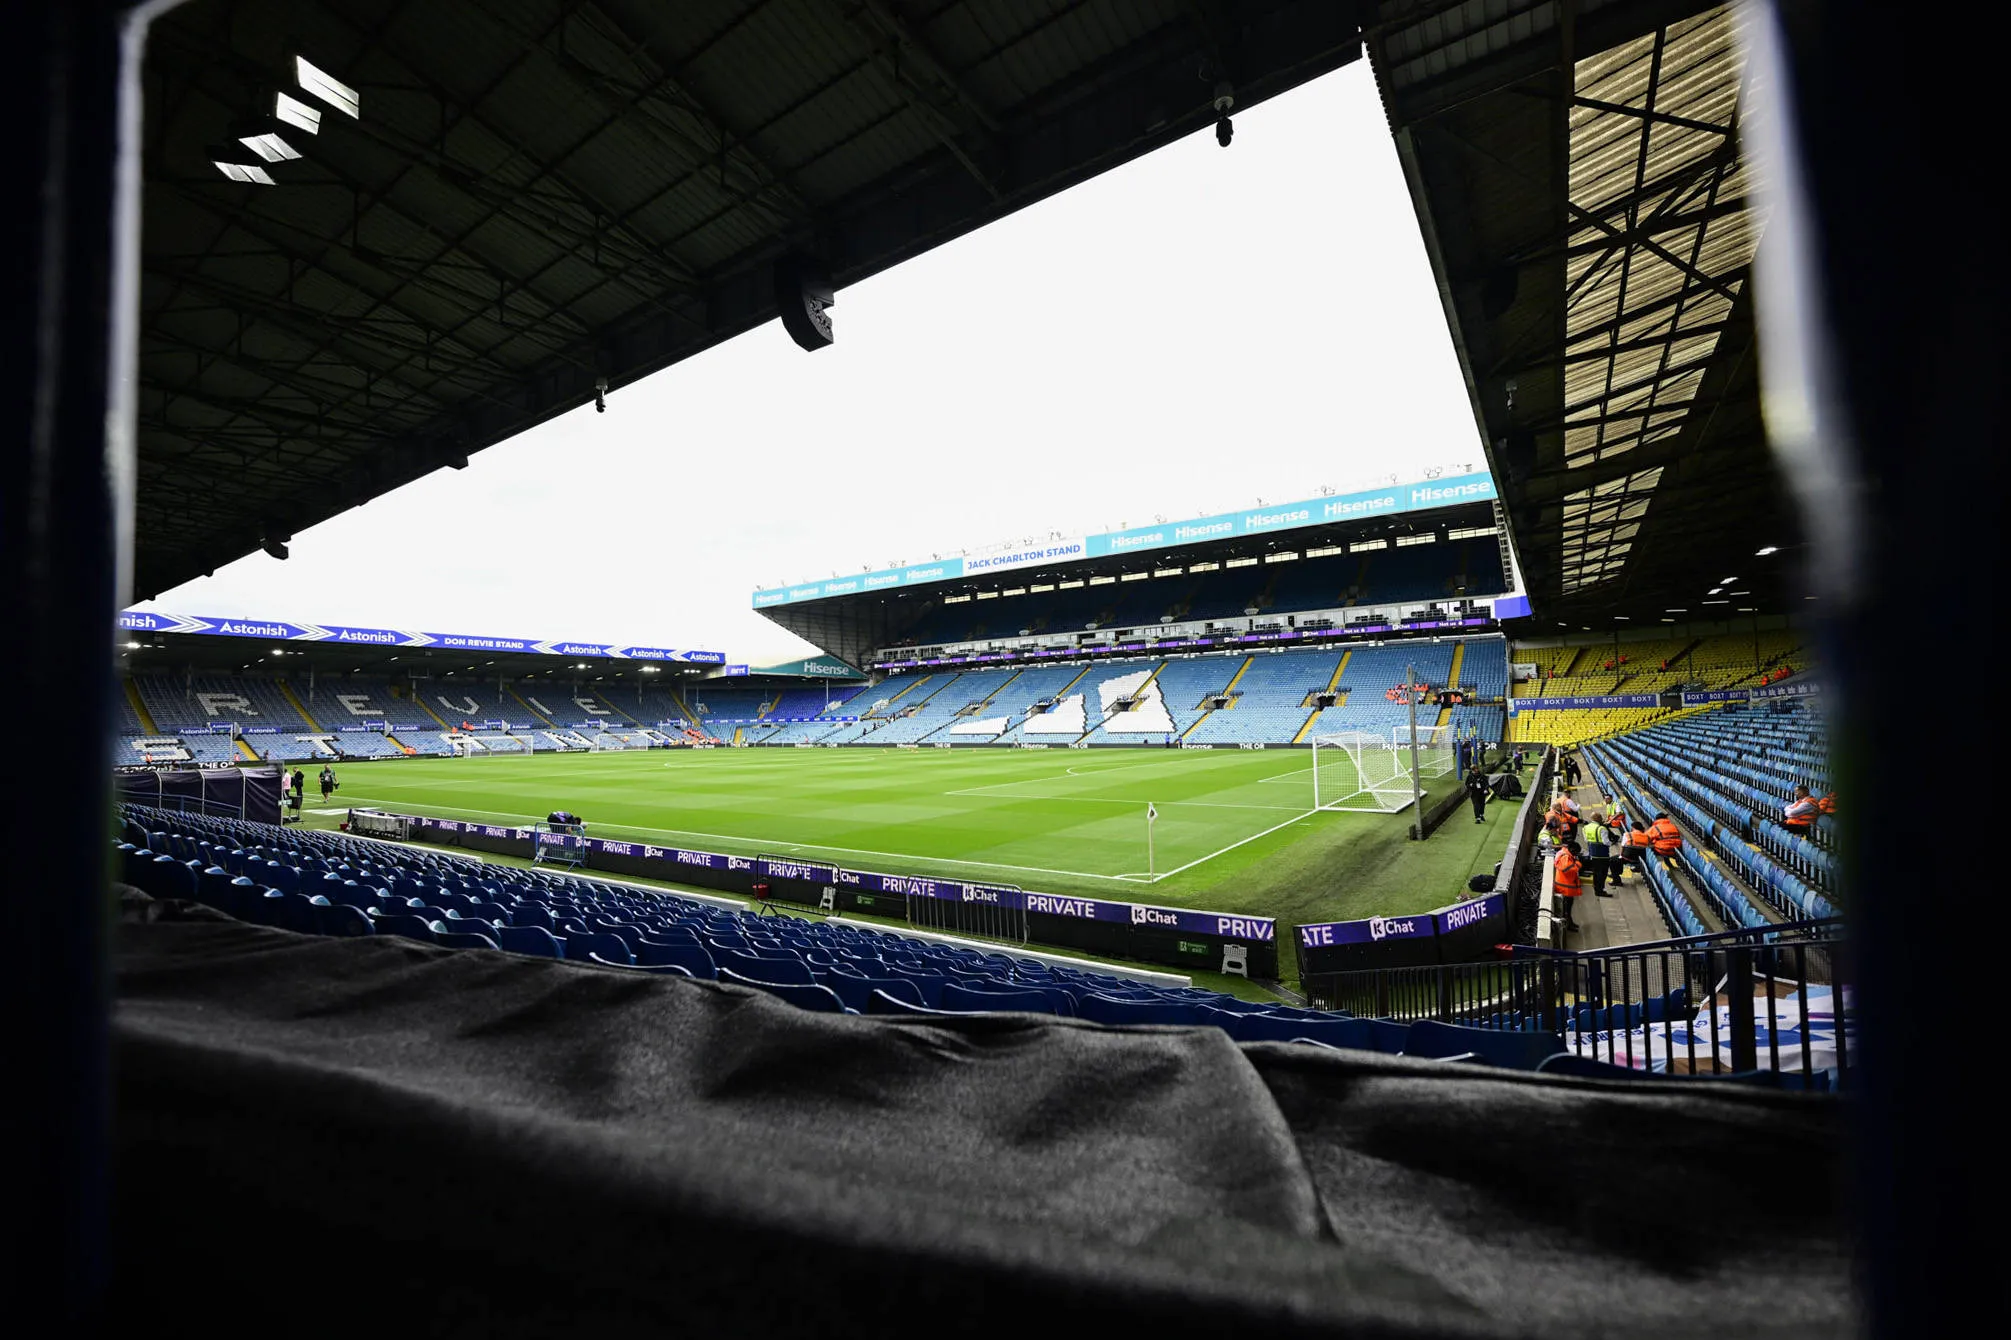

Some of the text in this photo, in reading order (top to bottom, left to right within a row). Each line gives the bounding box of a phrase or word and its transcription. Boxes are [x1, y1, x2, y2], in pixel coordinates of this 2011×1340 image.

[1411, 480, 1492, 504] Hisense
[1323, 494, 1396, 517] Hisense
[1245, 508, 1309, 529] Hisense
[1175, 520, 1233, 539] Hisense
[1111, 532, 1163, 548] Hisense
[967, 544, 1081, 570] JACK CHARLTON STAND
[864, 574, 899, 588] Hisense
[906, 567, 944, 580] Hisense
[219, 621, 288, 637] Astonish
[339, 629, 396, 643] Astonish
[444, 638, 524, 649] DON REVIE STAND
[563, 644, 602, 656] Astonish
[631, 648, 665, 659] Astonish
[689, 652, 720, 662] Astonish
[803, 661, 849, 675] Hisense
[485, 825, 507, 838] PRIVATE
[539, 833, 565, 846] PRIVATE
[603, 841, 631, 856] PRIVATE
[677, 851, 711, 866] PRIVATE
[768, 863, 811, 880] PRIVATE
[882, 877, 935, 897] PRIVATE
[1027, 894, 1095, 918] PRIVATE
[1447, 901, 1487, 929] PRIVATE
